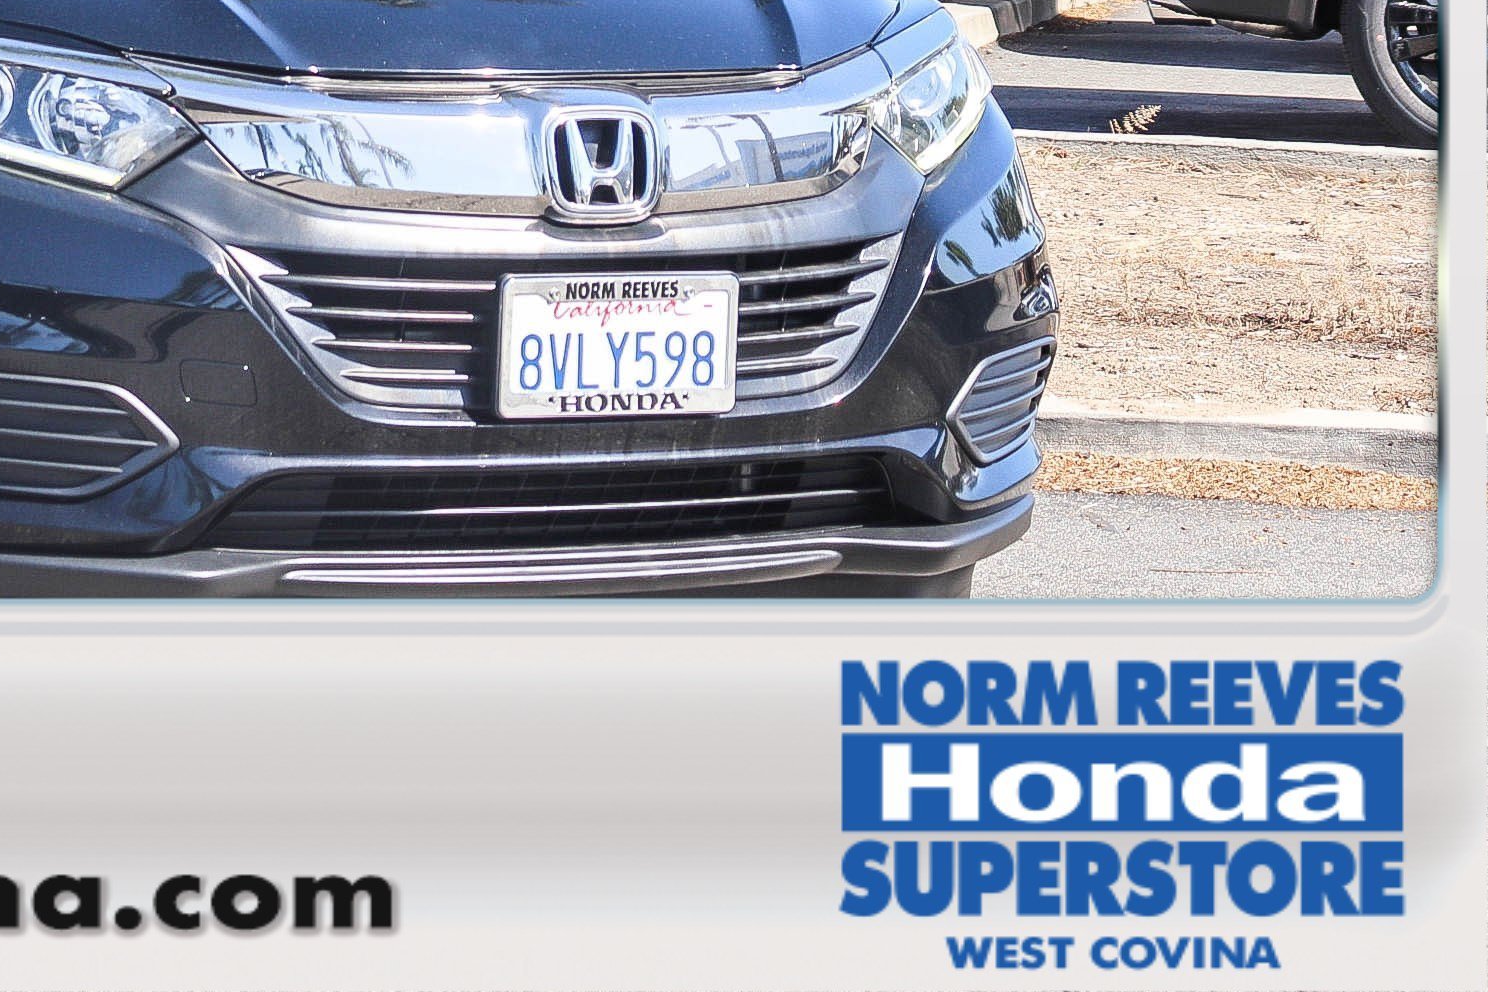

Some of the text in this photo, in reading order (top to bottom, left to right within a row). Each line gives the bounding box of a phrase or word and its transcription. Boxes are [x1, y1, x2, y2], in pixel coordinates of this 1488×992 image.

[565, 279, 679, 300] NORM REEVES
[553, 298, 693, 327] California
[520, 332, 714, 390] 8VLY598
[558, 392, 683, 413] HONDA
